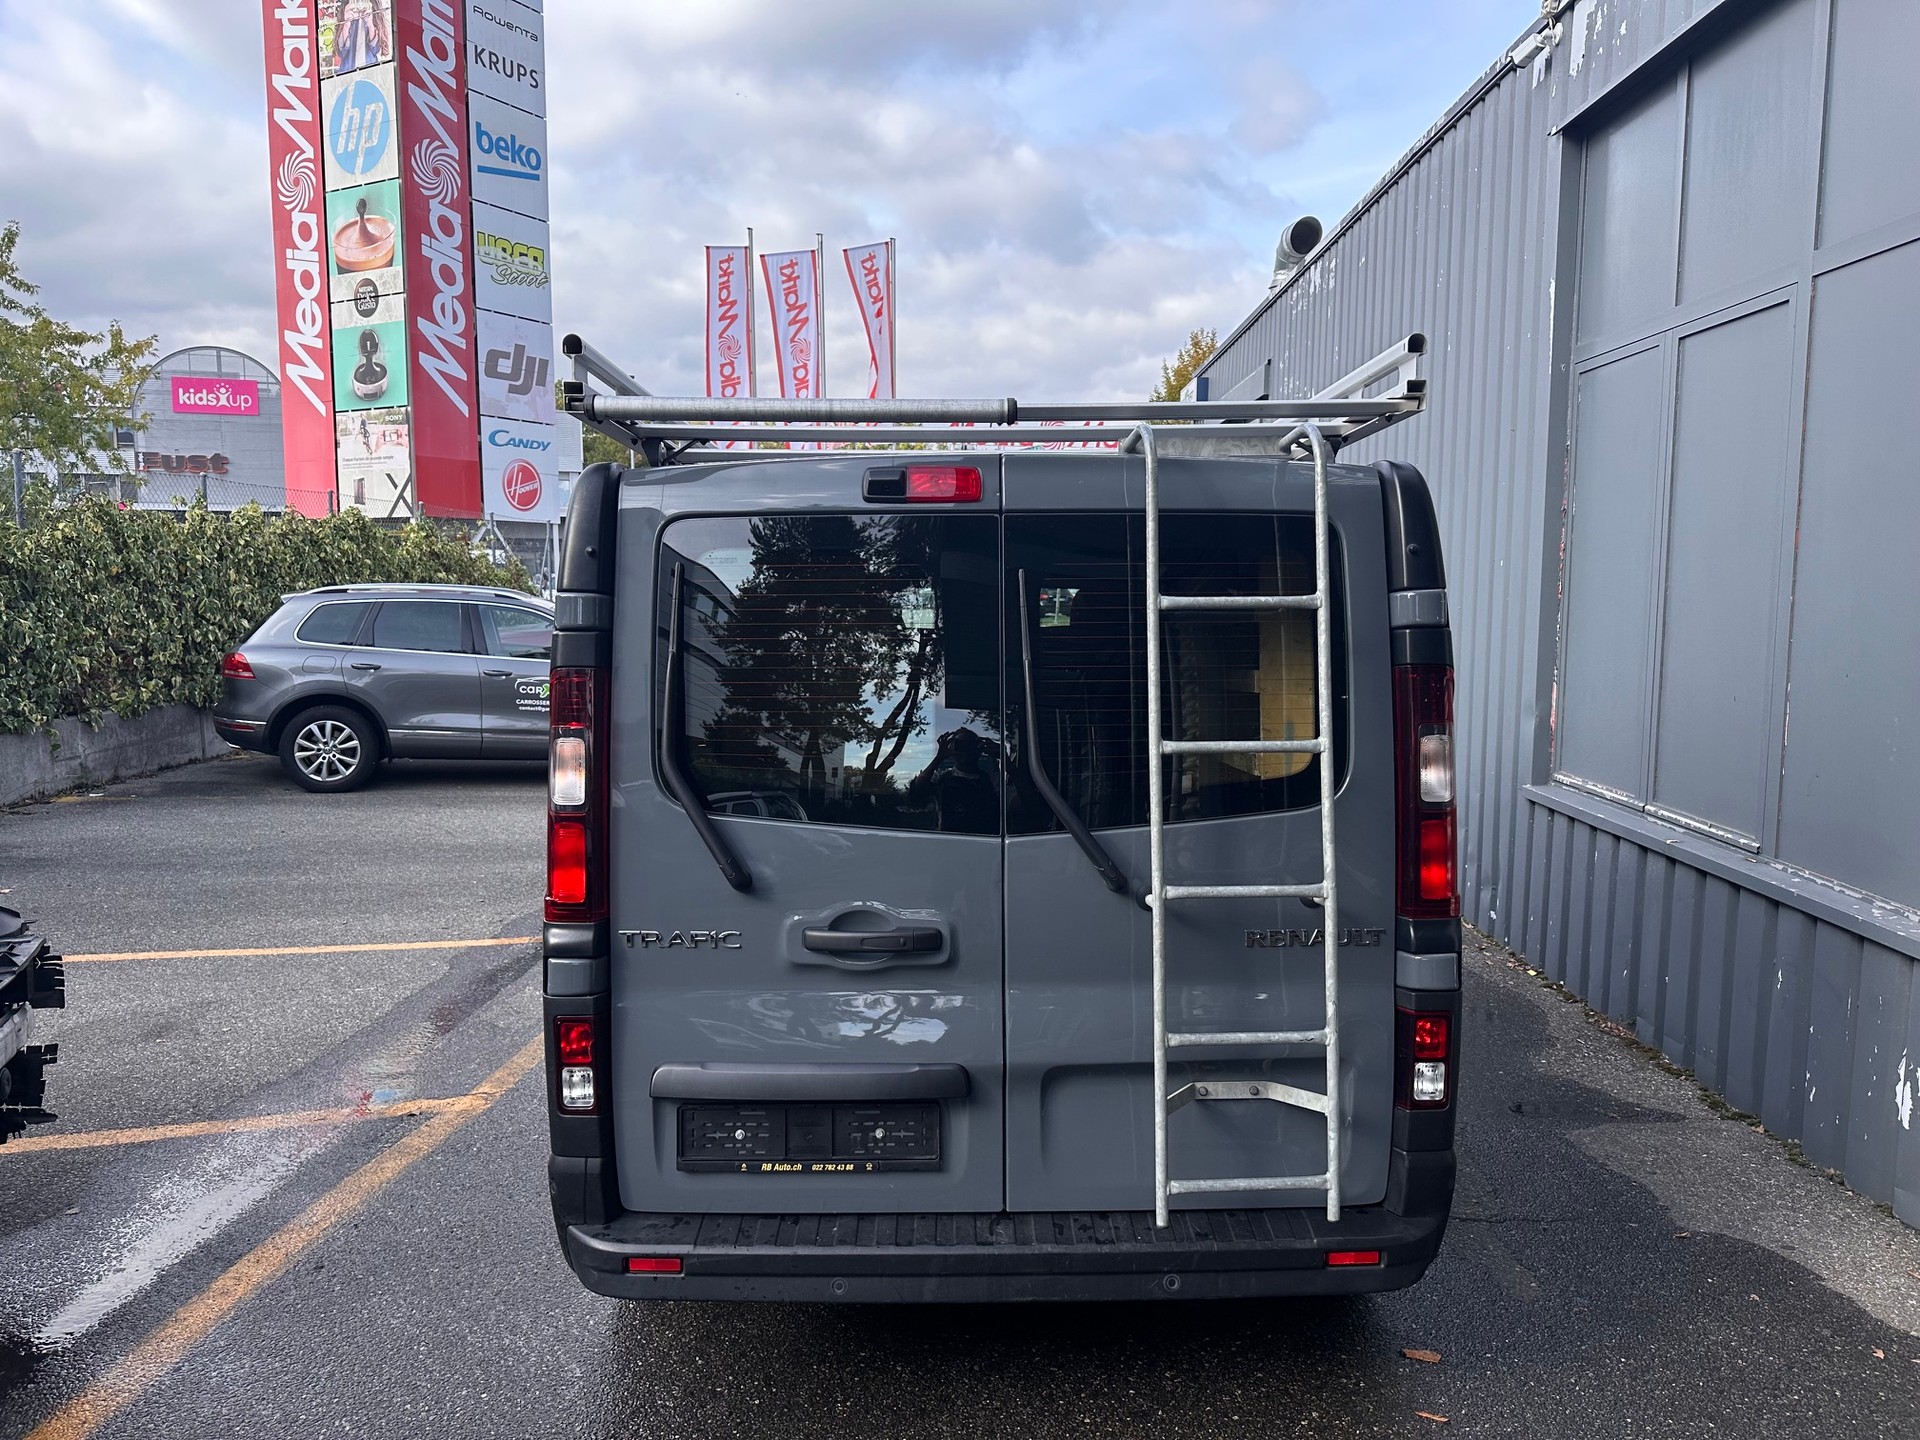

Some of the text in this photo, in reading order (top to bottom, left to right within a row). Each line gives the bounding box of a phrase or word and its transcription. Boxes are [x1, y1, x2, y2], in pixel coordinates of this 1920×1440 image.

[474, 45, 539, 89] KRUPS
[336, 81, 384, 175] hp
[475, 121, 542, 171] beko
[490, 264, 549, 288] Scoot
[178, 387, 252, 411] kids up
[385, 414, 403, 422] SONY
[618, 930, 742, 949] TRAFIC
[1244, 928, 1387, 947] RENAULT
[761, 1163, 772, 1171] RB
[773, 1163, 802, 1171] Auto.ch
